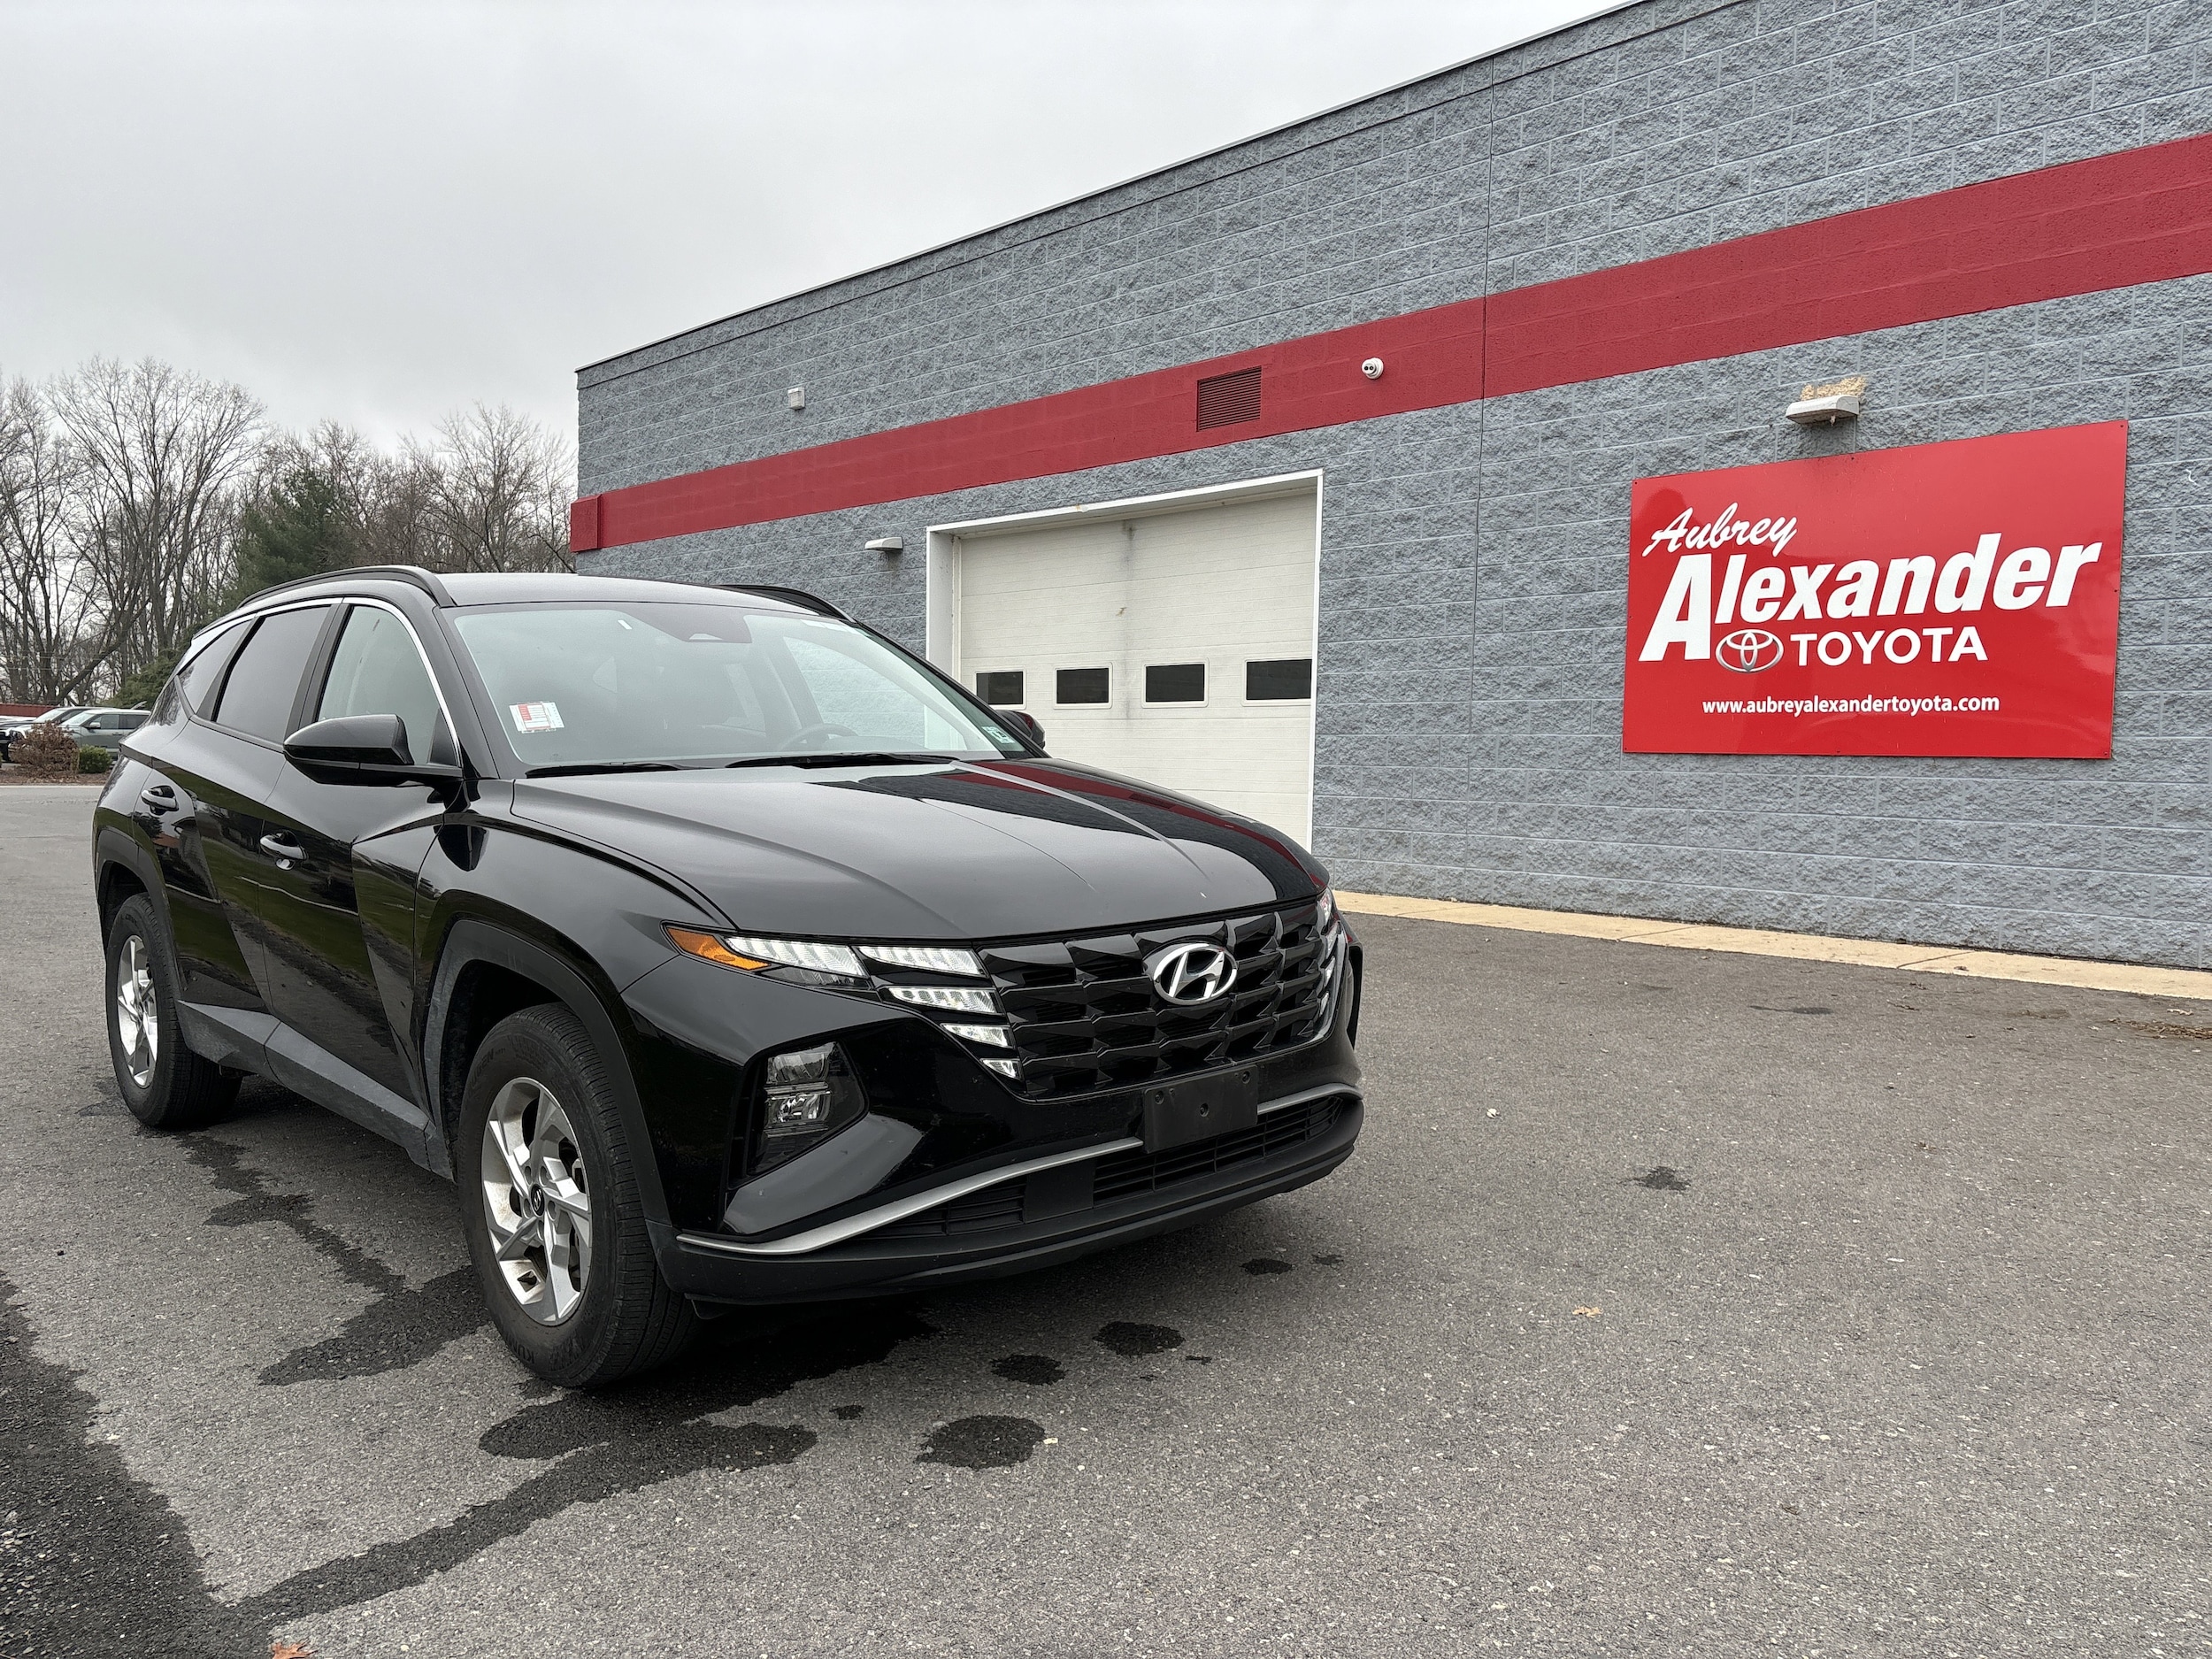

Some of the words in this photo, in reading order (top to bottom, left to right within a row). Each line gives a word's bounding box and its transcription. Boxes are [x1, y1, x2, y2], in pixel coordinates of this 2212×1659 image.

[1642, 502, 1797, 557] Aubrey
[1639, 533, 2103, 662] Alexander
[1791, 626, 1988, 666] TOYOTA
[1702, 694, 2000, 718] www.aubreyalexandertoyota.com
